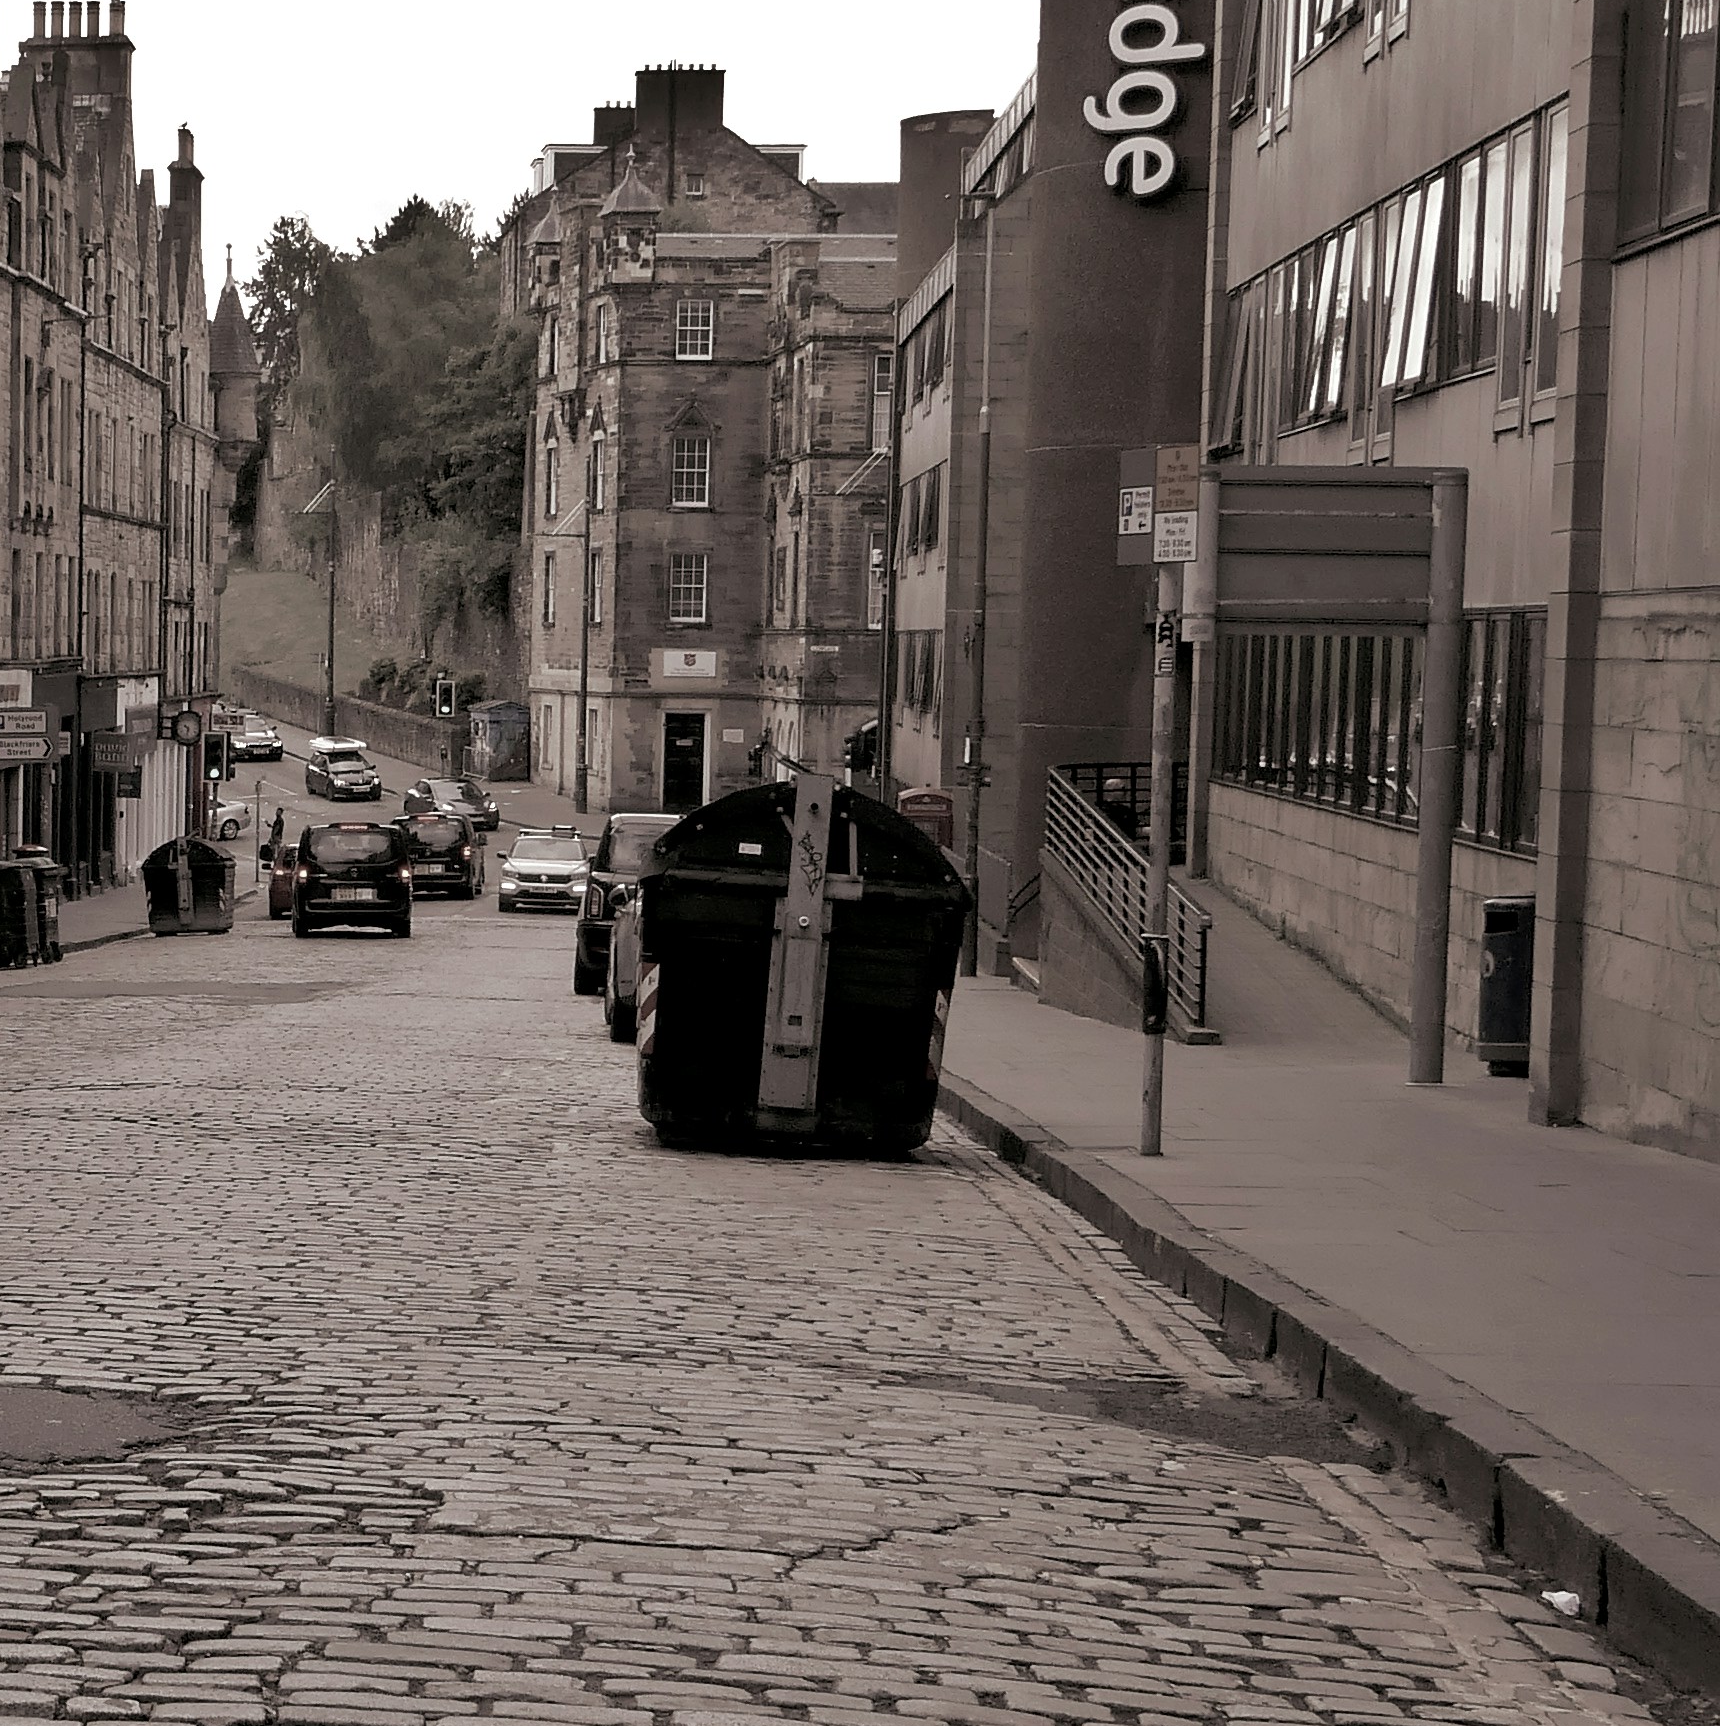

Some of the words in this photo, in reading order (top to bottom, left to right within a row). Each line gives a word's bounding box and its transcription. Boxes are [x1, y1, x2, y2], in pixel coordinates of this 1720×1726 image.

[8, 714, 43, 723] Holyrood
[15, 722, 36, 731] Road
[6, 748, 32, 756] Street
